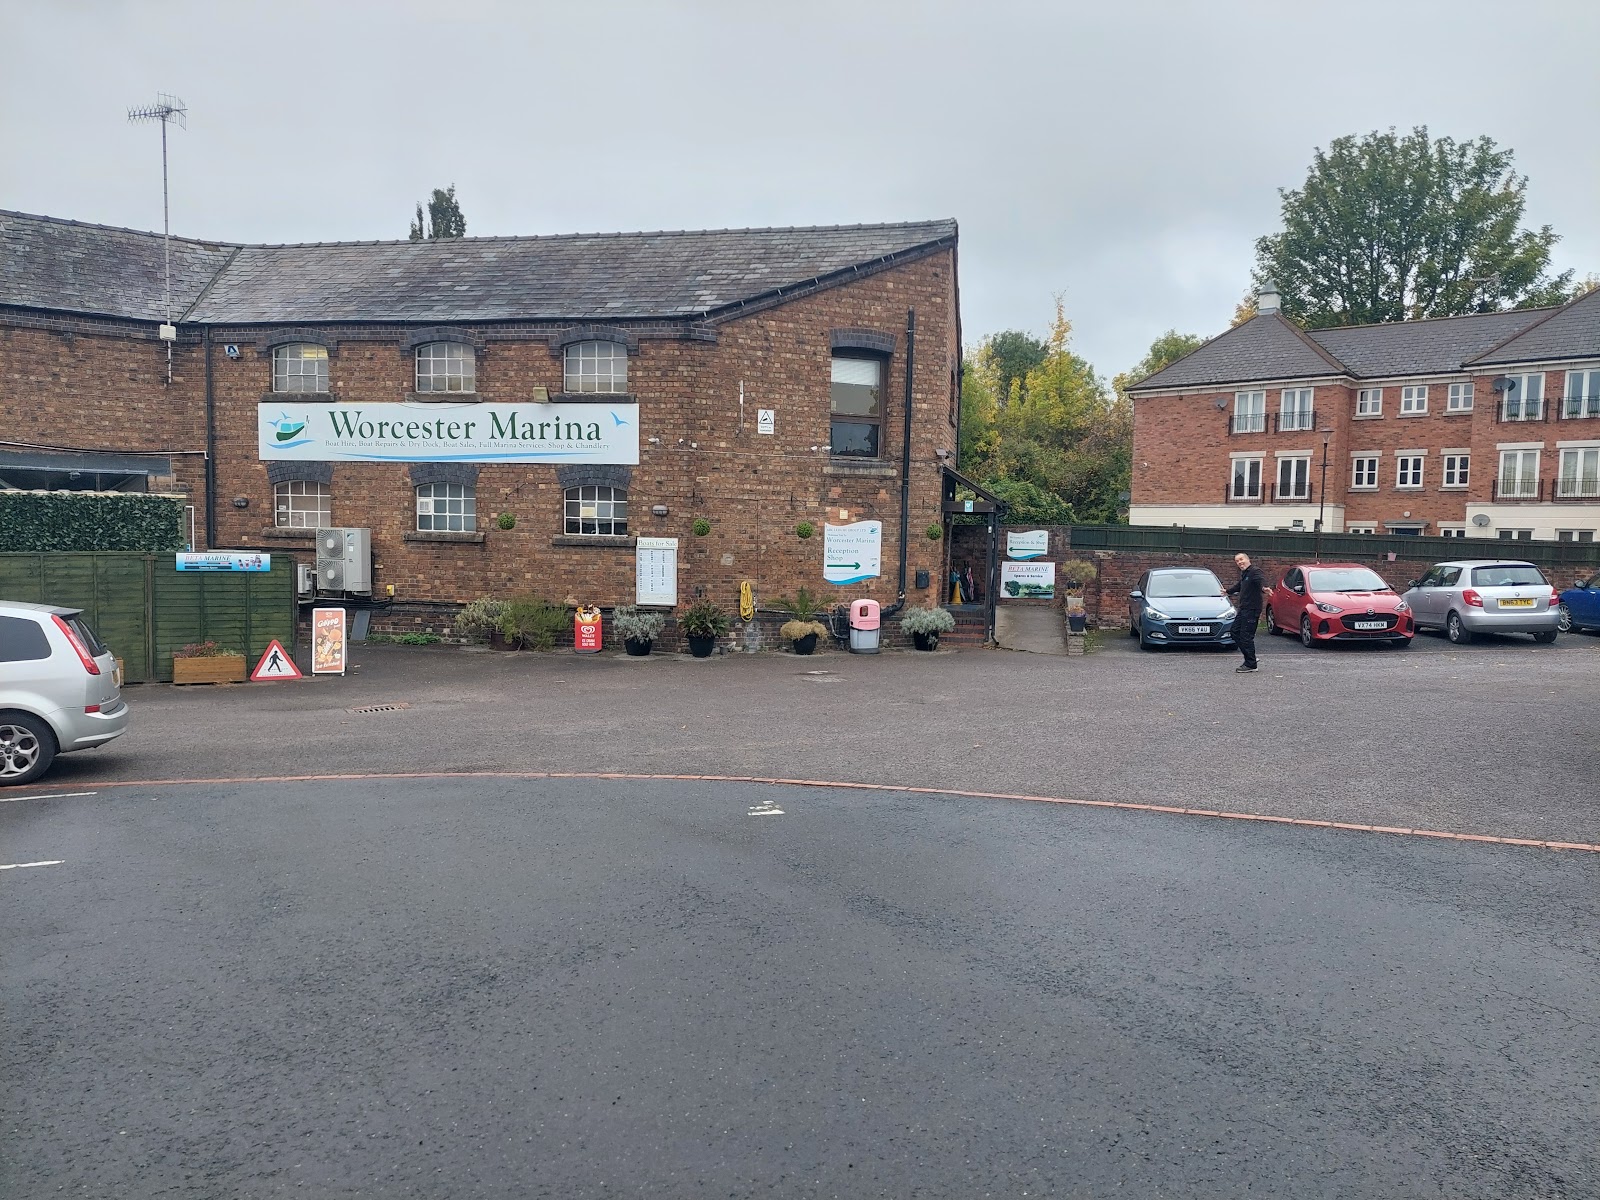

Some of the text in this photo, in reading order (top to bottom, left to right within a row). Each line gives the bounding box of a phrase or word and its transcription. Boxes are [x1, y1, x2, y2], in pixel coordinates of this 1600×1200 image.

[328, 411, 602, 441] Worcester Marina
[408, 441, 420, 449] Dry
[422, 441, 441, 449] Dock,
[548, 442, 565, 450] Shop
[575, 442, 610, 450] Chandlery
[827, 547, 859, 555] Reception
